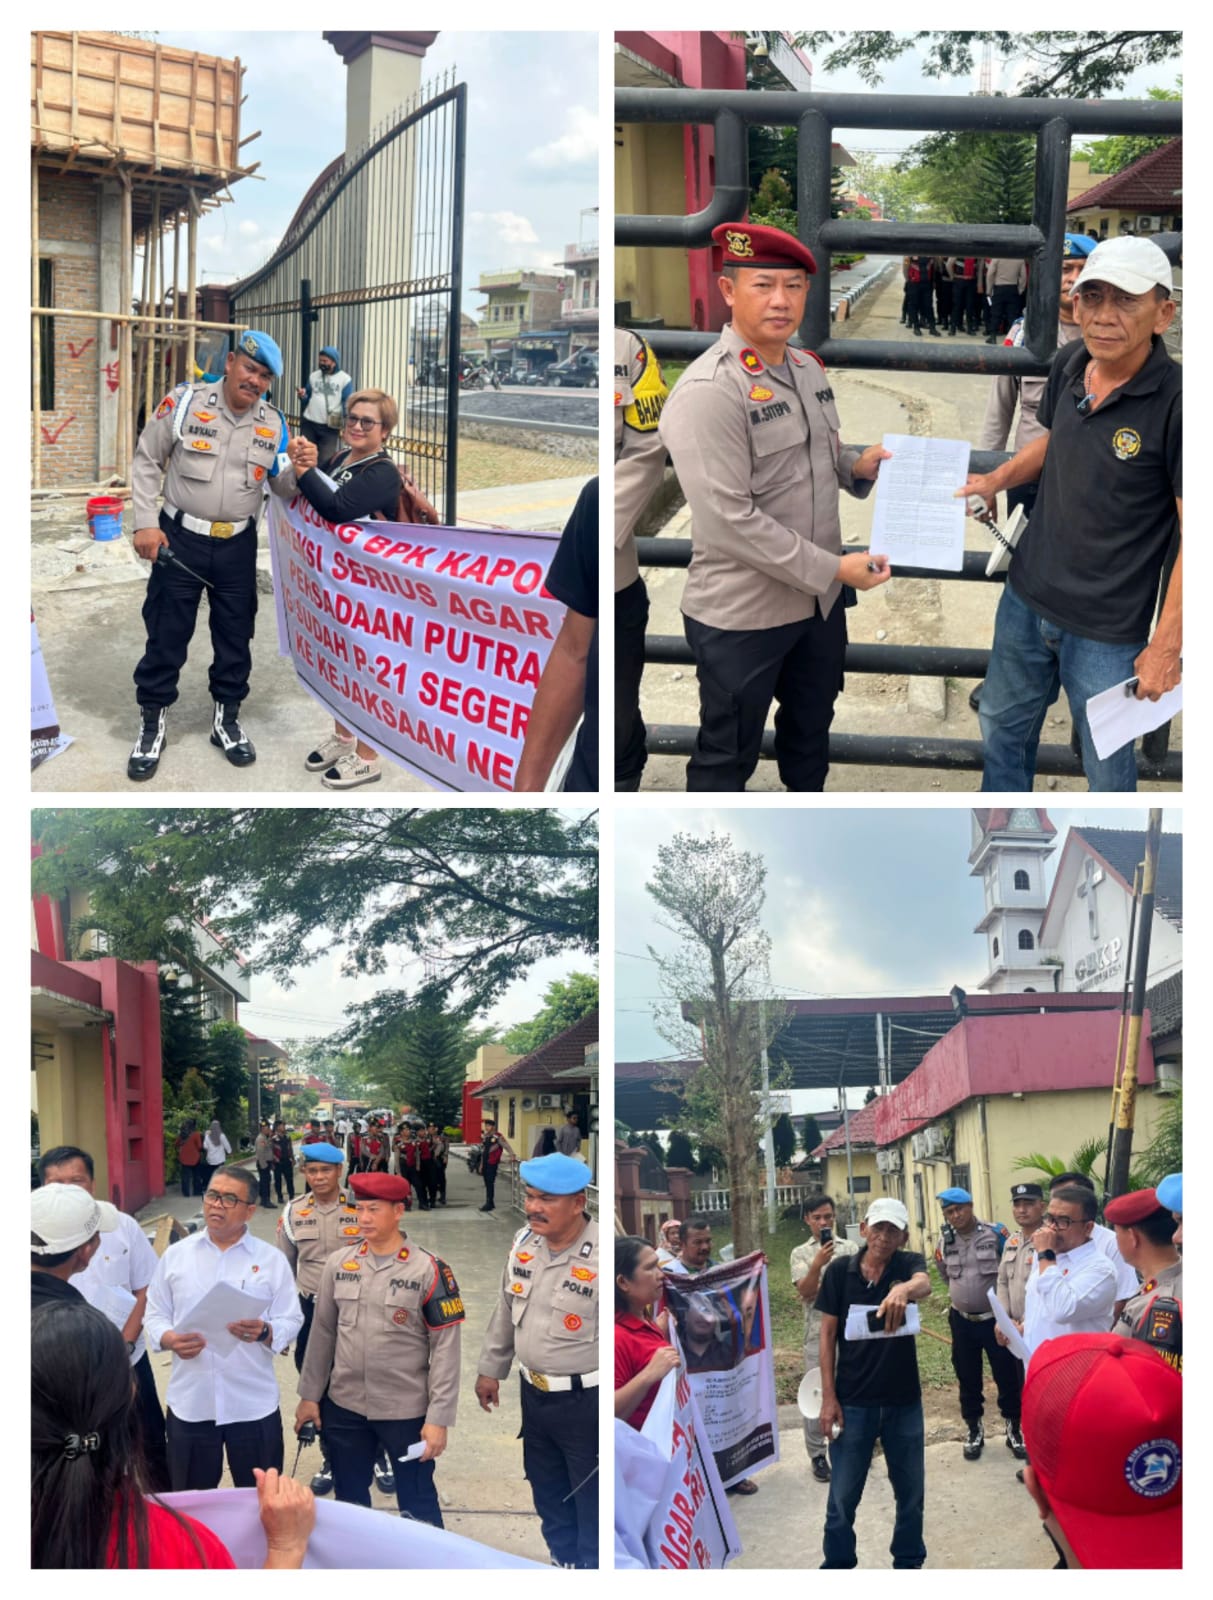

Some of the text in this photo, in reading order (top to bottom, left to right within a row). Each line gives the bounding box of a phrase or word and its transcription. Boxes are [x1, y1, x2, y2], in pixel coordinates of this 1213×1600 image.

[253, 438, 276, 451] POLRI
[363, 535, 437, 569] BPK
[289, 559, 541, 689] PERSADAAN PUTRA
[331, 551, 438, 608] SERIUS
[449, 591, 555, 640] AGAR
[296, 600, 349, 663] SUDAH
[353, 644, 407, 696] P-21
[295, 630, 314, 668] KE
[317, 651, 456, 764] KEJAKSAAN
[390, 1278, 421, 1291] POLRI
[562, 1280, 594, 1298] POLRI
